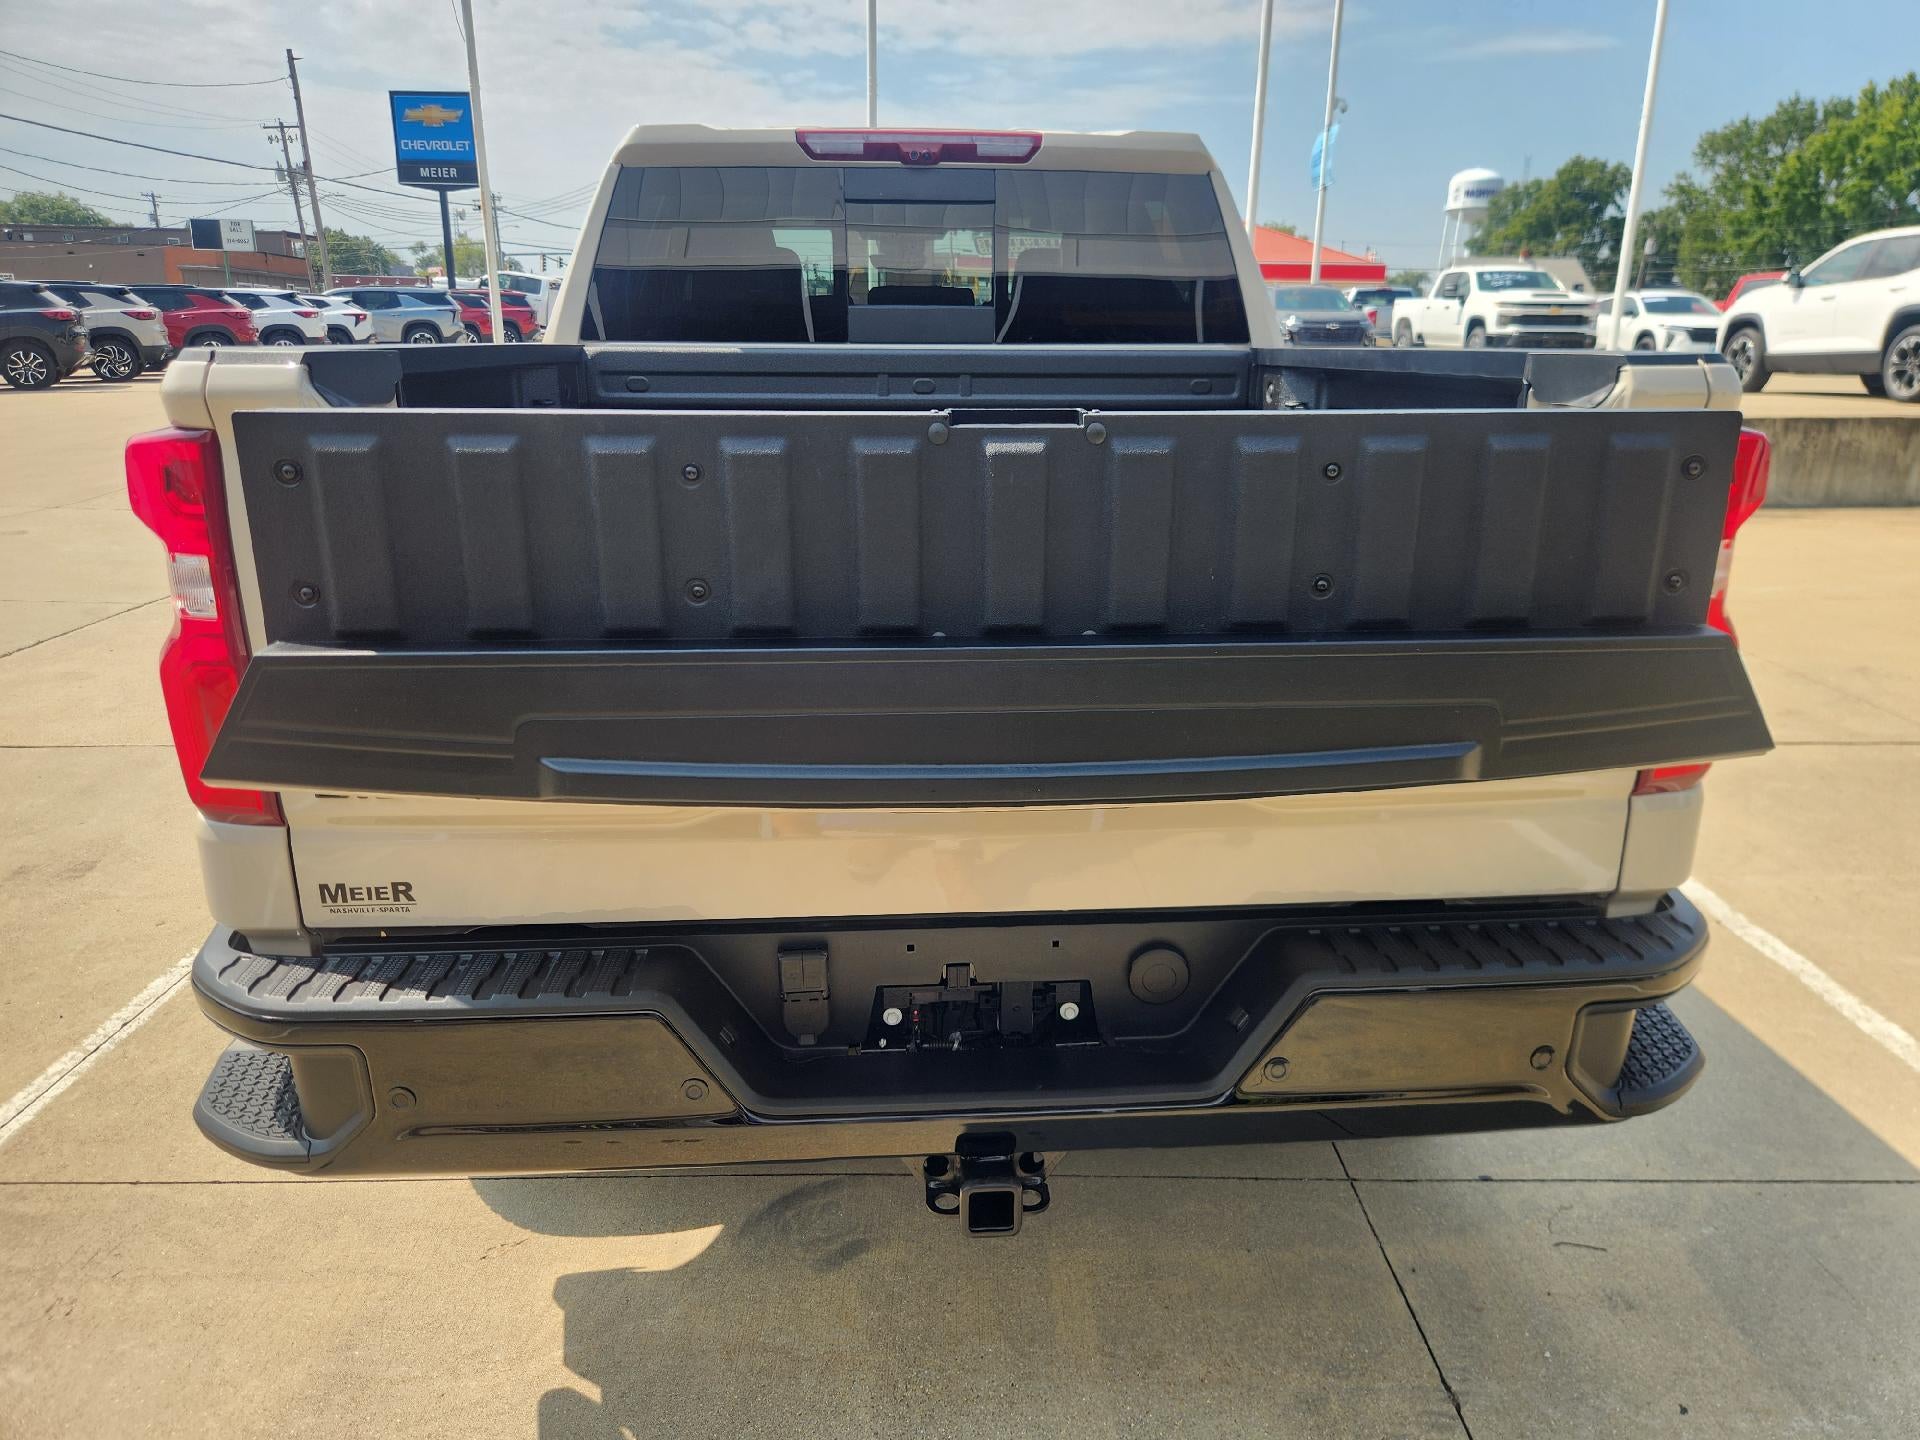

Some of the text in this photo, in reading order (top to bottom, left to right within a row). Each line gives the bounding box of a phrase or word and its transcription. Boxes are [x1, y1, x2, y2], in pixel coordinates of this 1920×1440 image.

[400, 139, 470, 151] CHEVROLET
[420, 167, 457, 178] MEIER
[319, 881, 416, 904] MEIER
